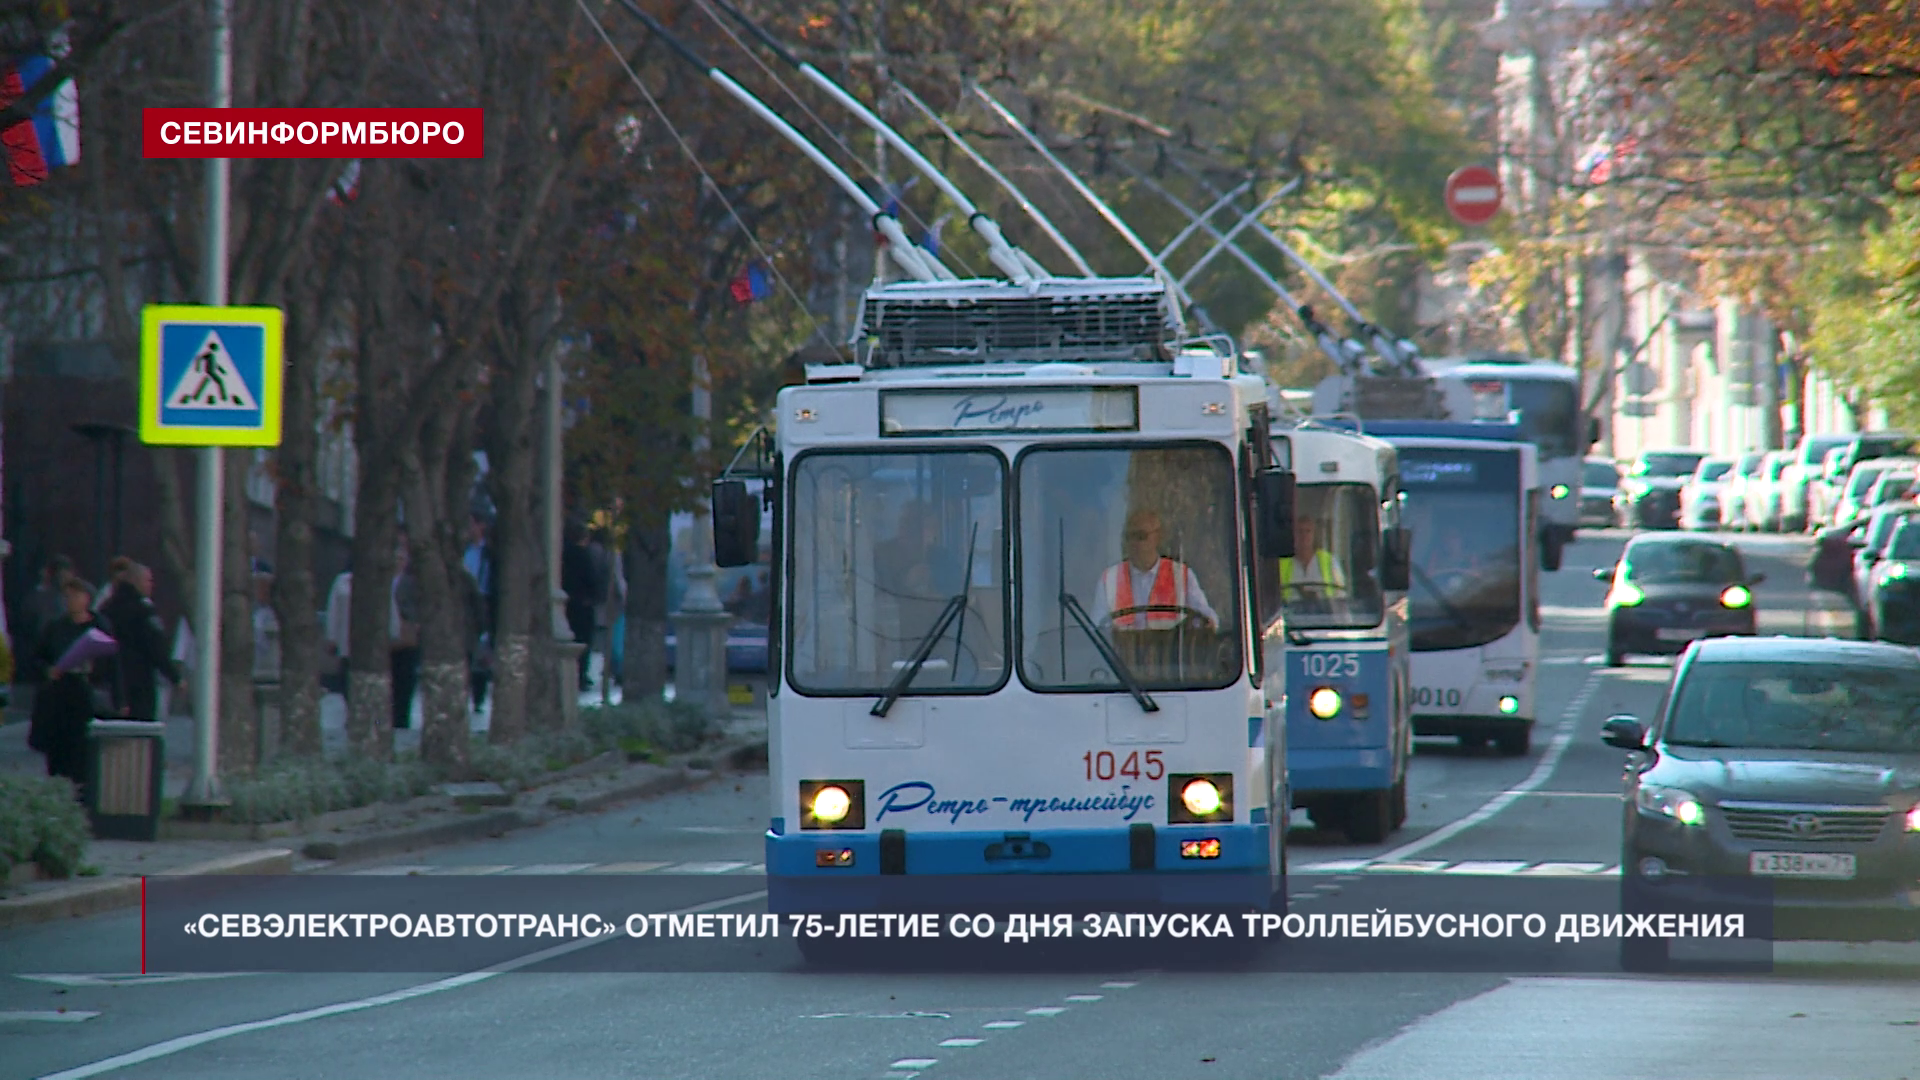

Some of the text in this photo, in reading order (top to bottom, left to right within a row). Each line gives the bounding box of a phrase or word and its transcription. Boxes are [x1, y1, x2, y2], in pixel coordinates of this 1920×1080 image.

[952, 394, 1044, 427] Ретро
[1301, 653, 1359, 676] 1025
[1083, 750, 1165, 781] 1045
[876, 781, 1155, 825] Ретро-троллейбус
